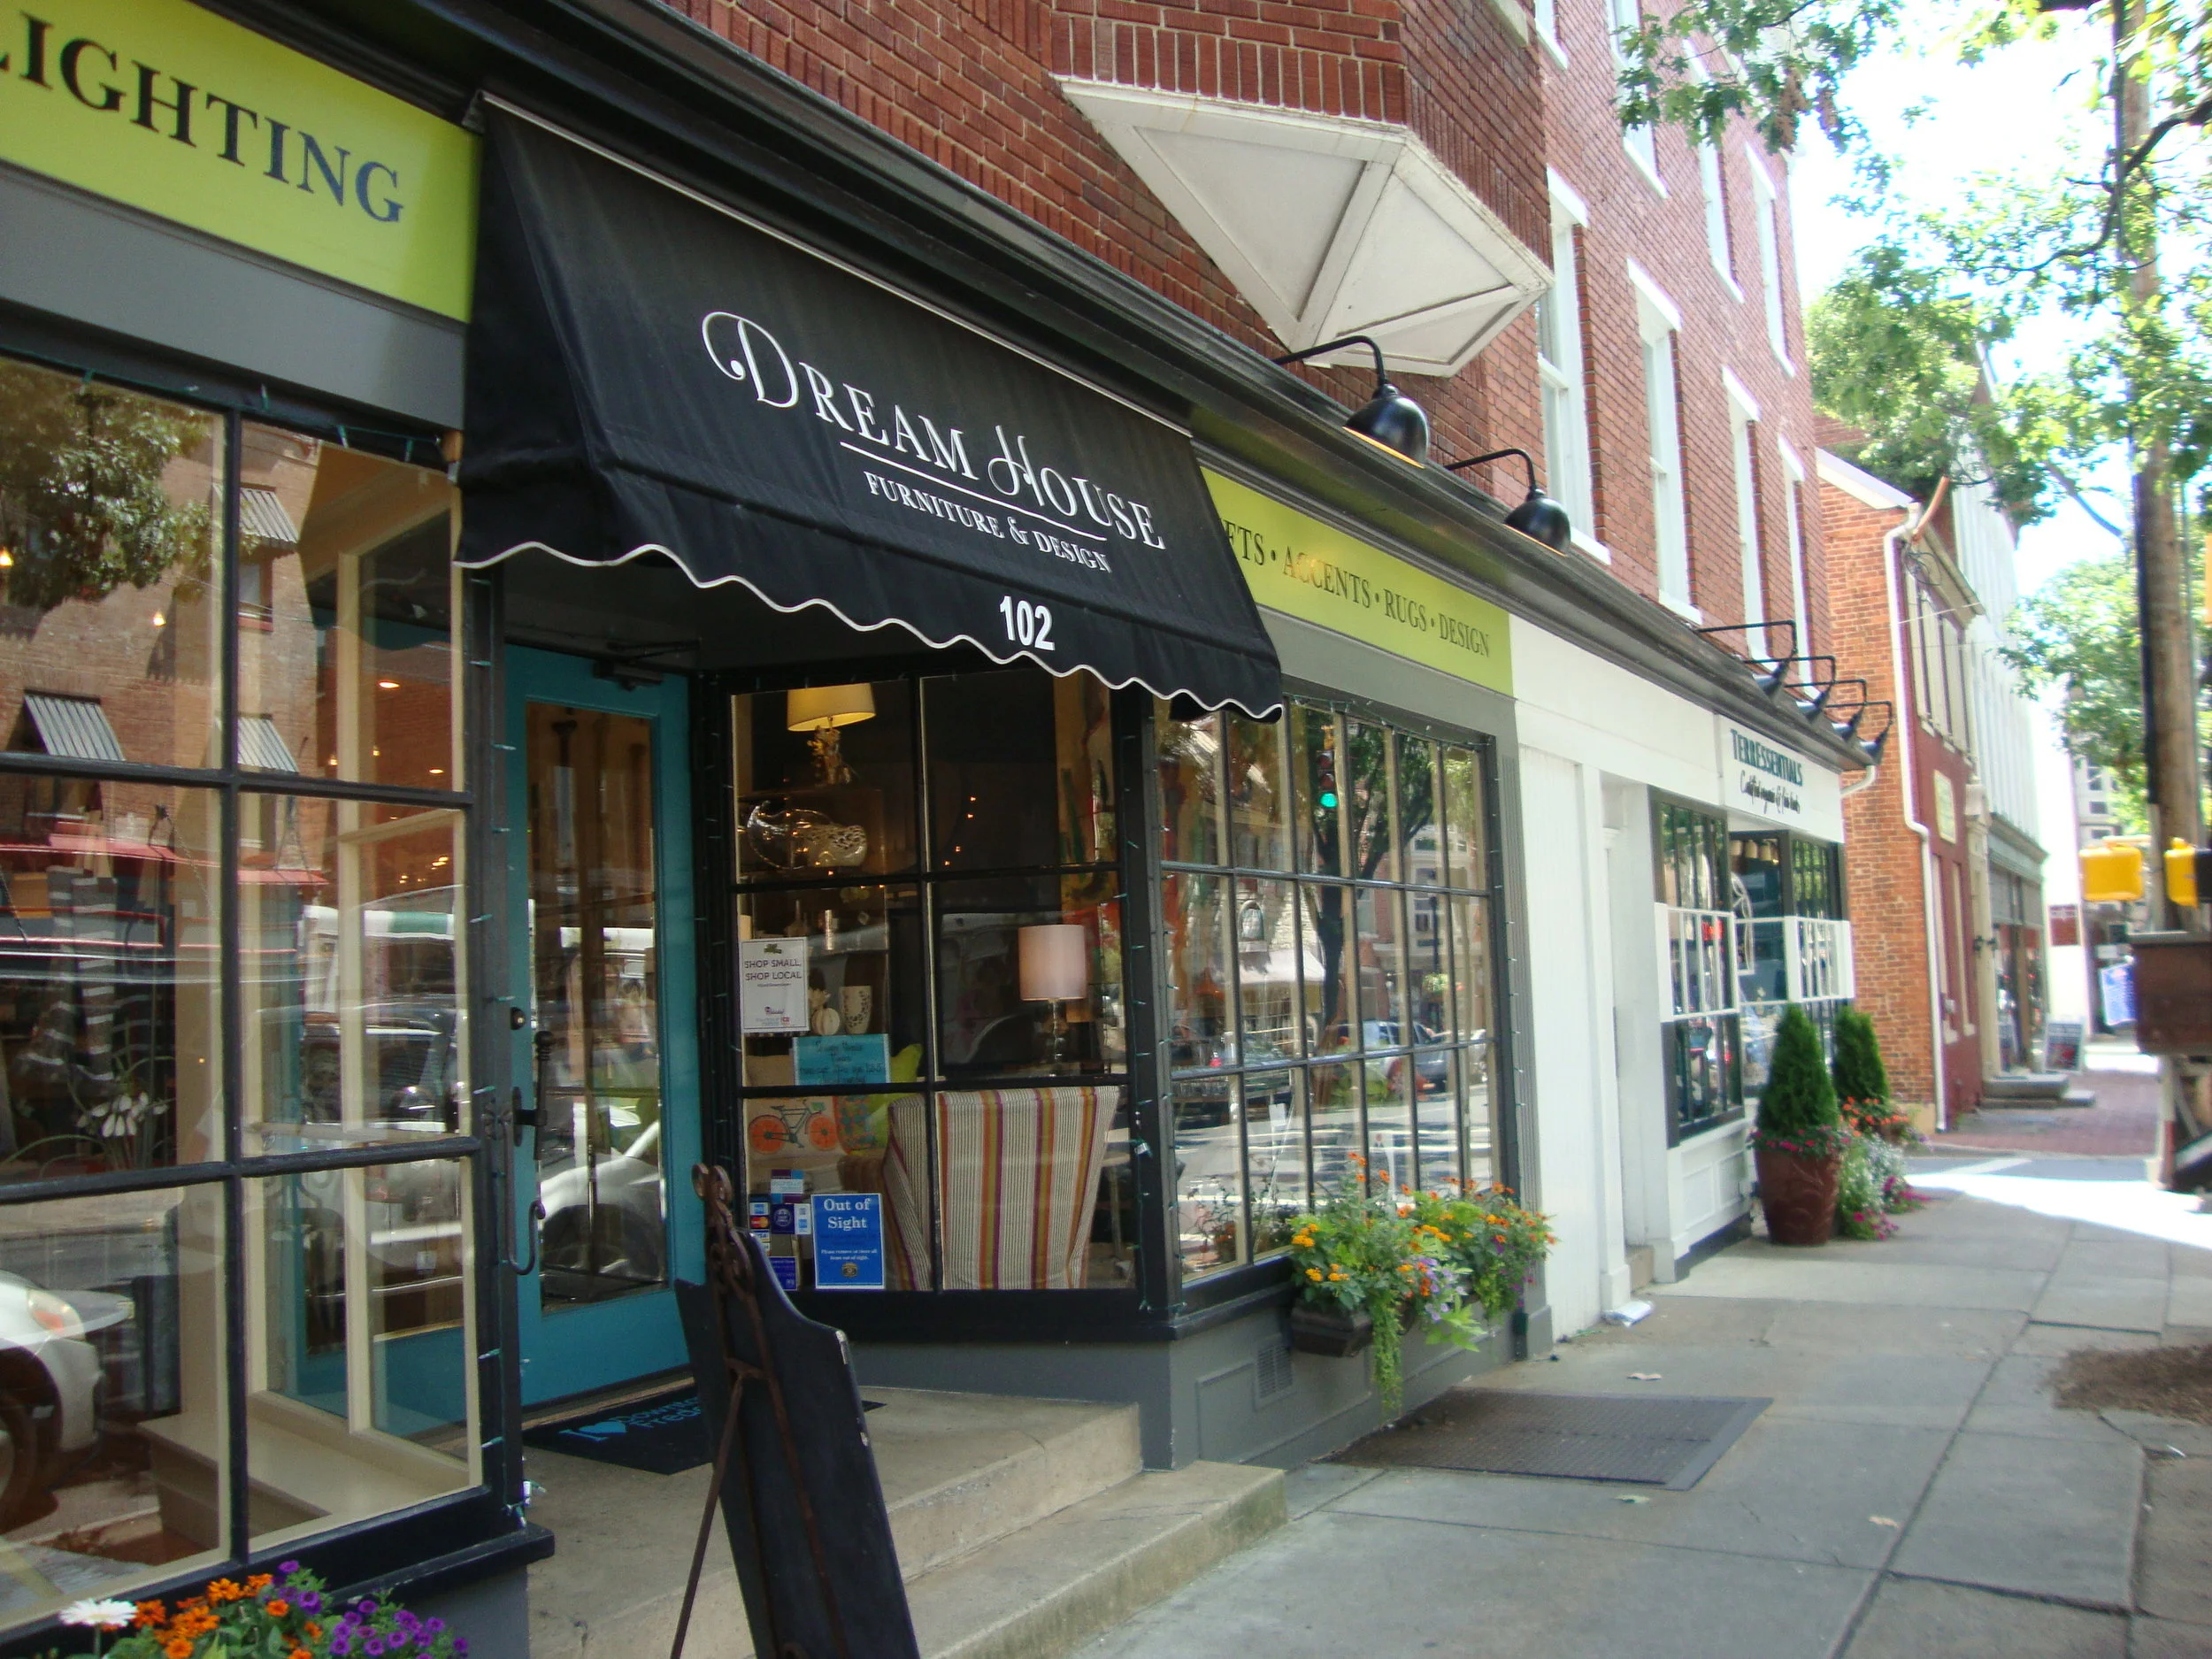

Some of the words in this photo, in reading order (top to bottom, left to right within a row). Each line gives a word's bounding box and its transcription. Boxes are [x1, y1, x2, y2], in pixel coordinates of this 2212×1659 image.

[0, 11, 404, 224] IGHTING
[702, 311, 979, 480] DREAM
[987, 425, 1166, 550] HOUSE
[863, 471, 1005, 540] FURNITURE
[1009, 516, 1030, 546] &
[1033, 529, 1112, 573] DESIGN
[999, 595, 1055, 651] 102
[1282, 545, 1371, 609] ACCENTS
[1383, 588, 1427, 632] RUGS
[1438, 612, 1490, 658] DESIGN
[744, 960, 768, 969] SHOP
[745, 972, 770, 981] SHOP
[772, 971, 803, 979] LOCAL
[824, 1198, 851, 1211] Out
[855, 1197, 871, 1210] of
[827, 1216, 868, 1232] Sight
